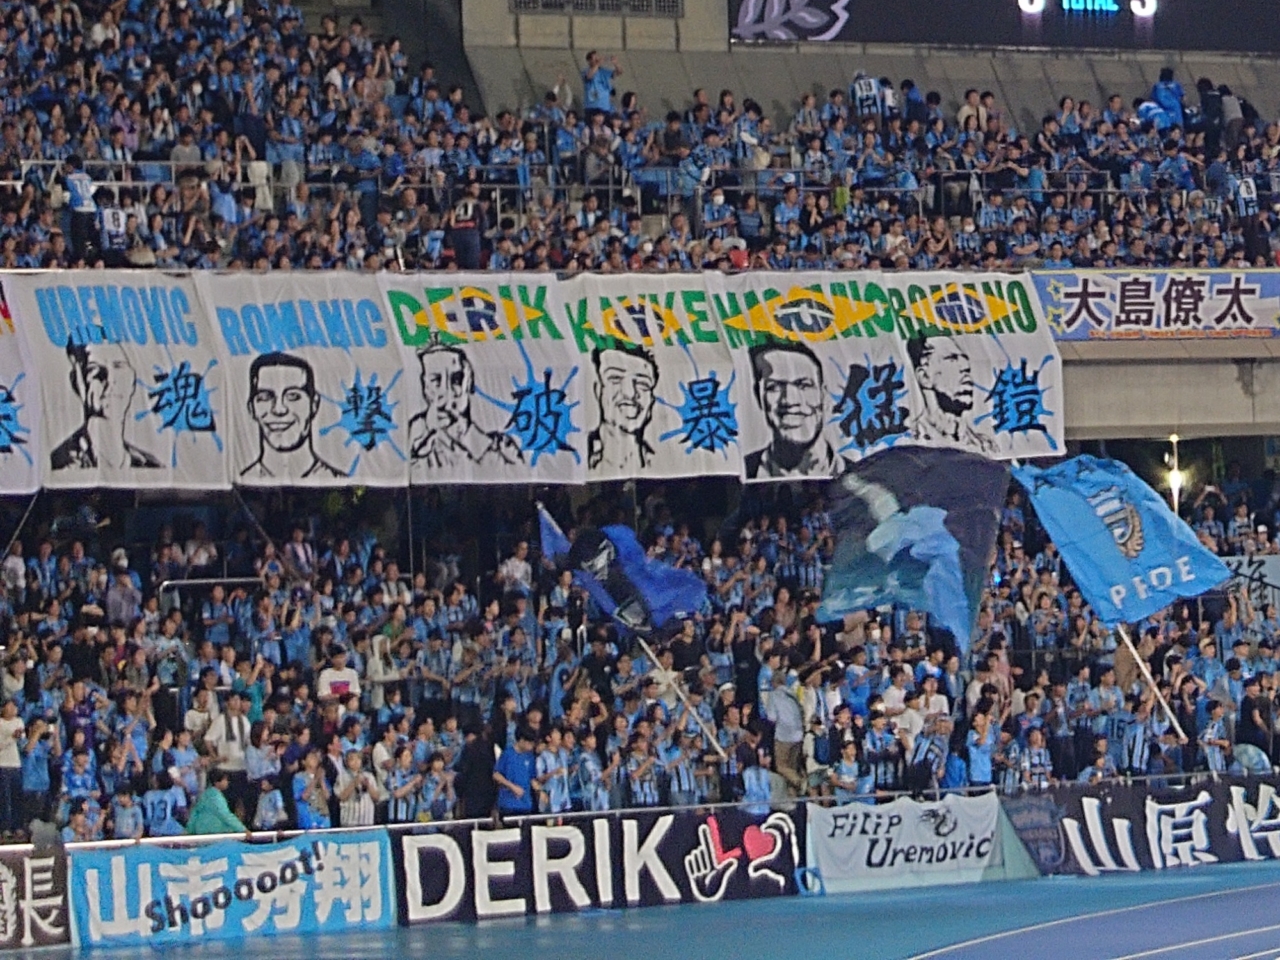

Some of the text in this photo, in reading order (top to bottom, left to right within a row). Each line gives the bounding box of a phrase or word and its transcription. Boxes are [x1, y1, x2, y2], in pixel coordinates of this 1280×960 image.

[216, 298, 388, 357] ROMANIC
[386, 285, 566, 347] DERIK
[564, 290, 720, 354] KAYKE
[1063, 275, 1259, 329] 大島僚太
[148, 362, 217, 432] 魂
[505, 371, 577, 452] 破
[680, 378, 739, 452] 暴
[402, 814, 681, 921] DERIK
